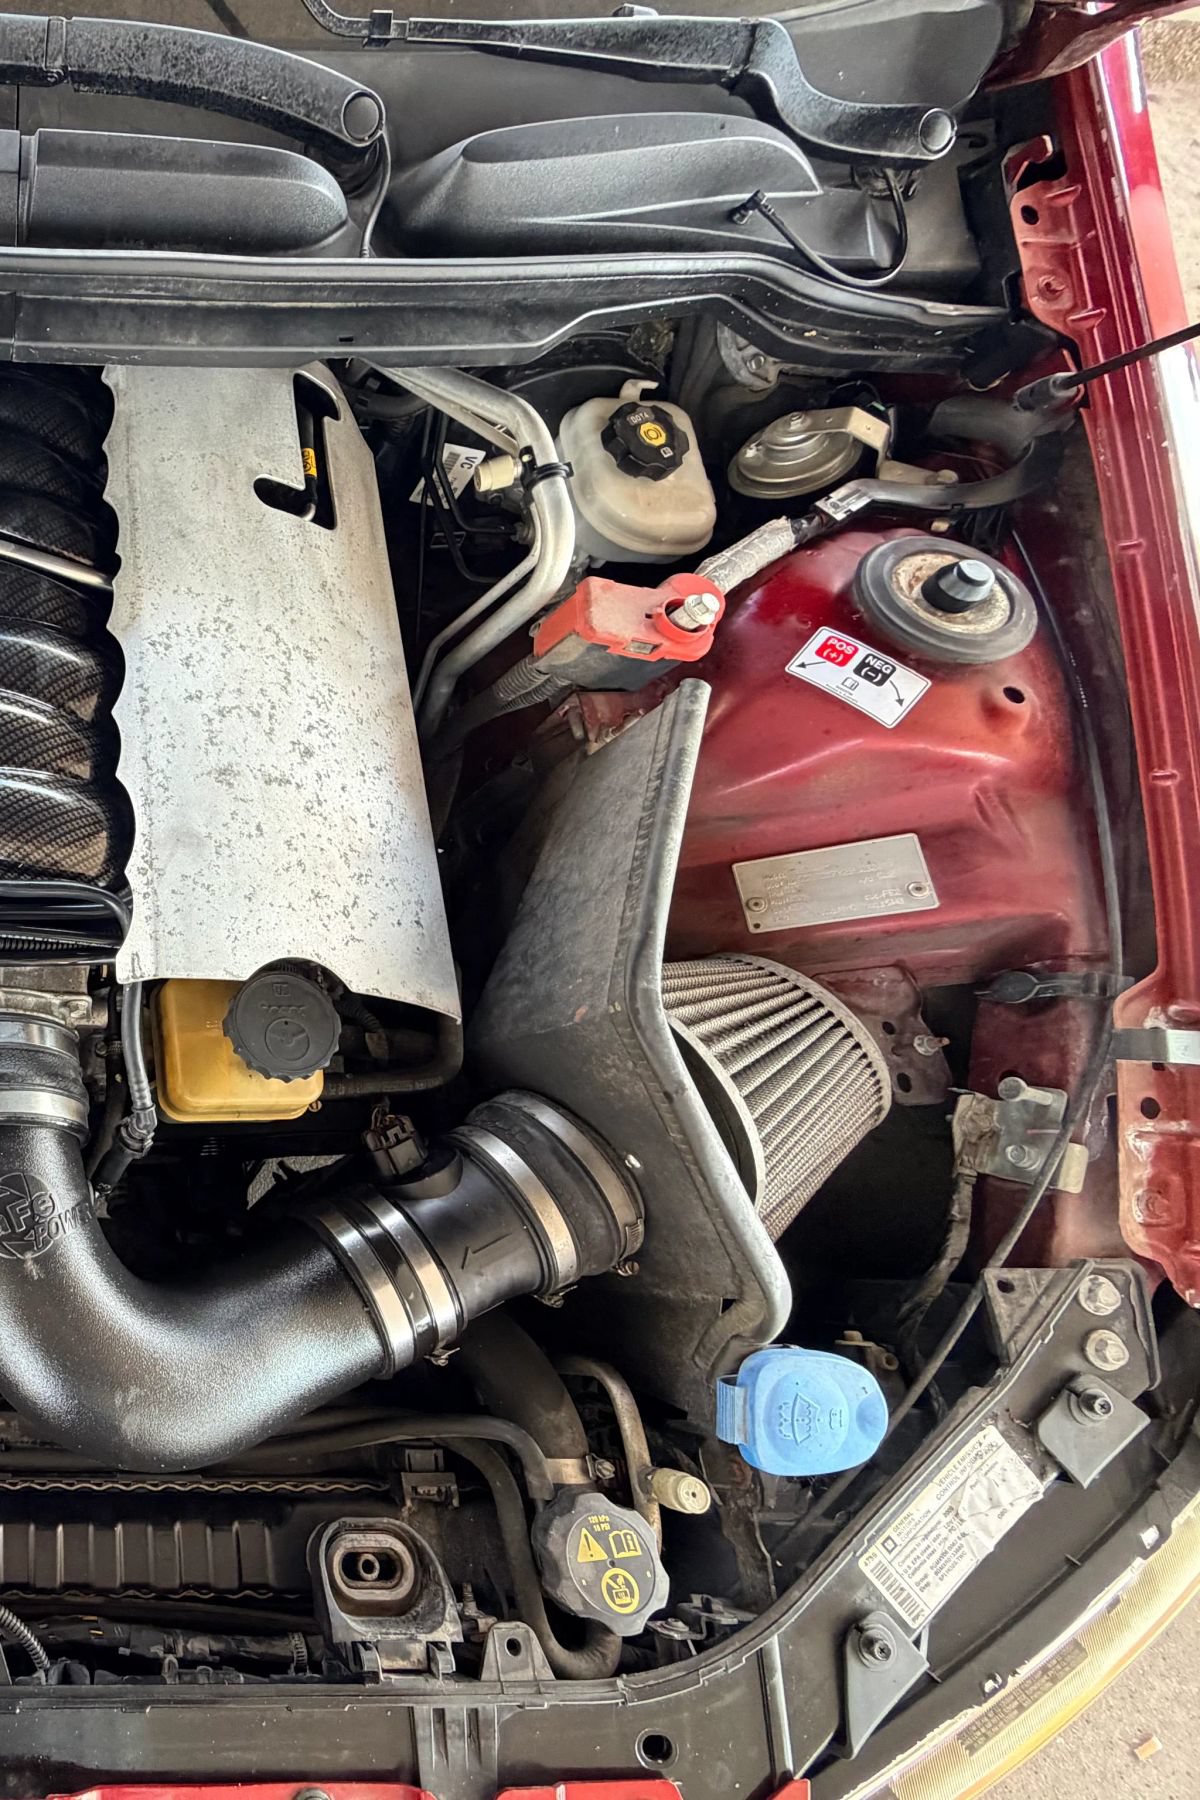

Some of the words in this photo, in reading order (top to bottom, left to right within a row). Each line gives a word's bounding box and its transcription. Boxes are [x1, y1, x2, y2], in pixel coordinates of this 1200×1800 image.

[827, 637, 855, 655] POS
[865, 655, 893, 675] NEG
[934, 1473, 960, 1500] CONTROL
[936, 1463, 958, 1487] VEHICLE
[891, 1510, 913, 1533] GENERAL
[898, 1507, 932, 1543] CORPORATION
